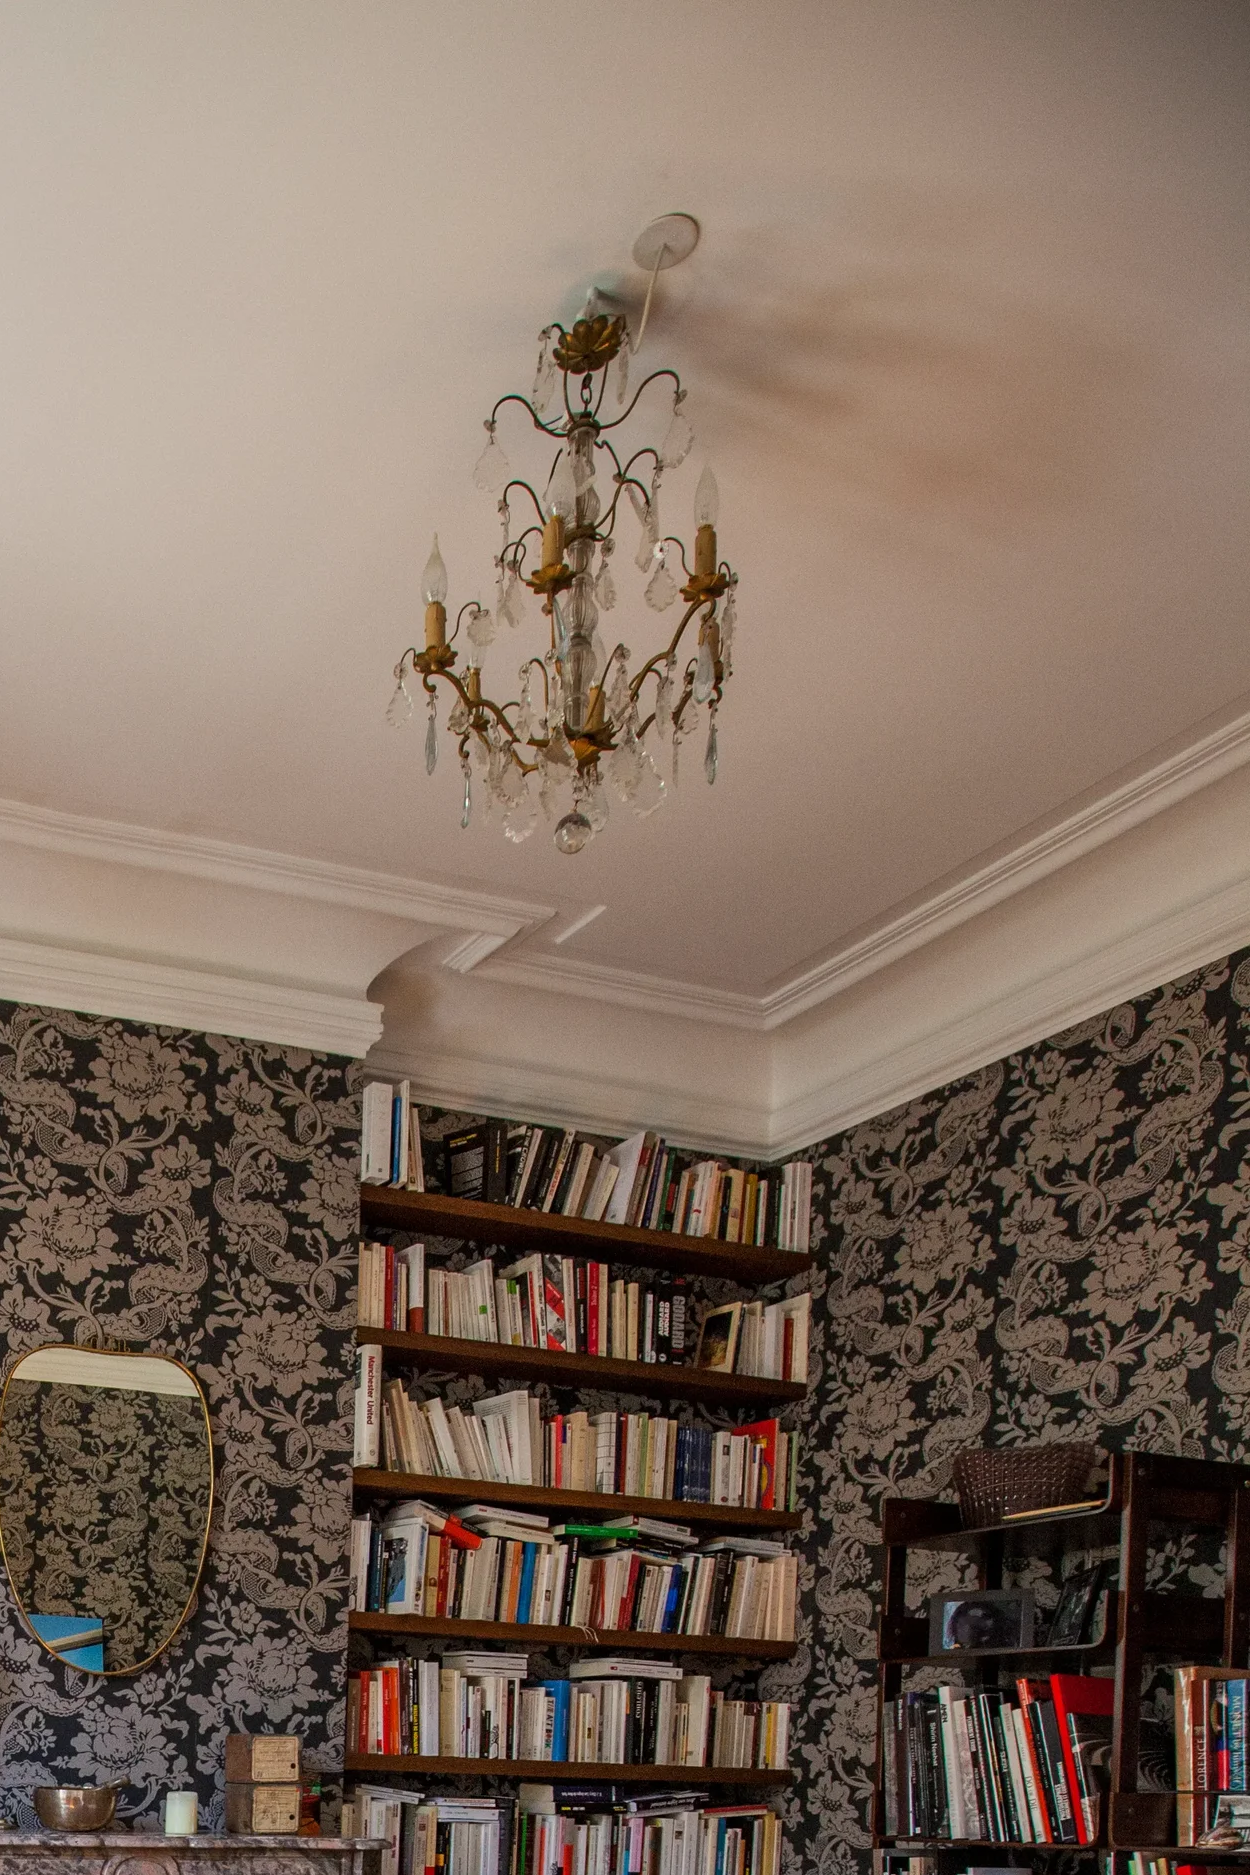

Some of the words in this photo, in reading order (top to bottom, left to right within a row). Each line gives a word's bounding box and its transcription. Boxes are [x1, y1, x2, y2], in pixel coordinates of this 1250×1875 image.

[517, 1147, 529, 1174] CROWD
[672, 1295, 686, 1349] GODARD
[367, 1356, 375, 1399] Manchester
[366, 1401, 374, 1425] United
[940, 1703, 948, 1723] AMEN
[1231, 1695, 1242, 1733] MONET
[545, 1729, 553, 1749] BOOK
[929, 1722, 937, 1742] Shirin
